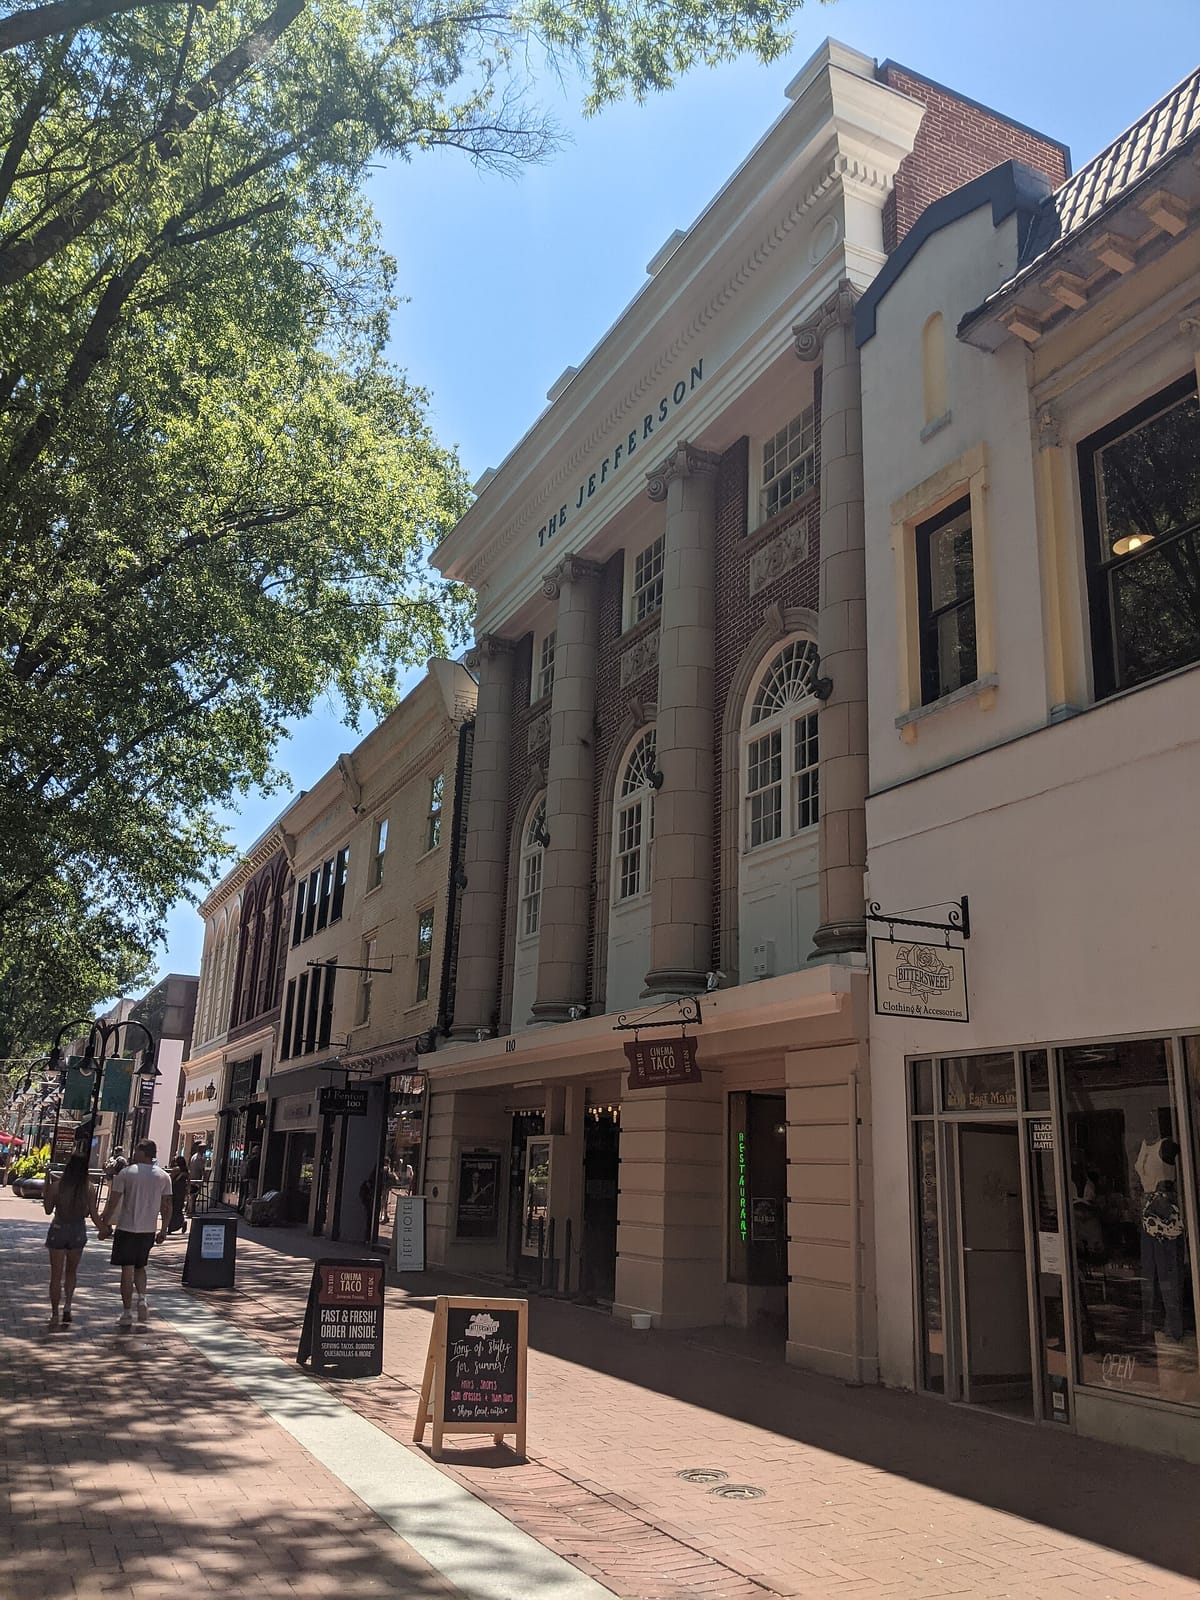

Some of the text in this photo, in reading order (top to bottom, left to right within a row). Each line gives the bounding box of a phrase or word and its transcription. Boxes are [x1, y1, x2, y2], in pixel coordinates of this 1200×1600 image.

[538, 358, 704, 547] THE JEFFERSON
[898, 967, 948, 989] BITTERSWEET
[882, 1001, 963, 1018] Clothing & Accessories
[505, 1039, 516, 1053] 110
[649, 1045, 674, 1057] CINEMA
[650, 1055, 676, 1071] TACO
[969, 1092, 988, 1105] East
[1033, 1141, 1054, 1150] MATTE
[737, 1132, 748, 1241] RESTAURANT
[402, 1200, 413, 1232] HOTEL
[340, 1272, 362, 1281] CINEMA
[340, 1281, 362, 1292] TACO
[320, 1309, 377, 1324] FAST & FRESH!
[320, 1324, 378, 1339] ORDER INSIDE.
[474, 1341, 484, 1357] of
[456, 1356, 508, 1377] for summer!
[1102, 1352, 1136, 1380] OPEN
